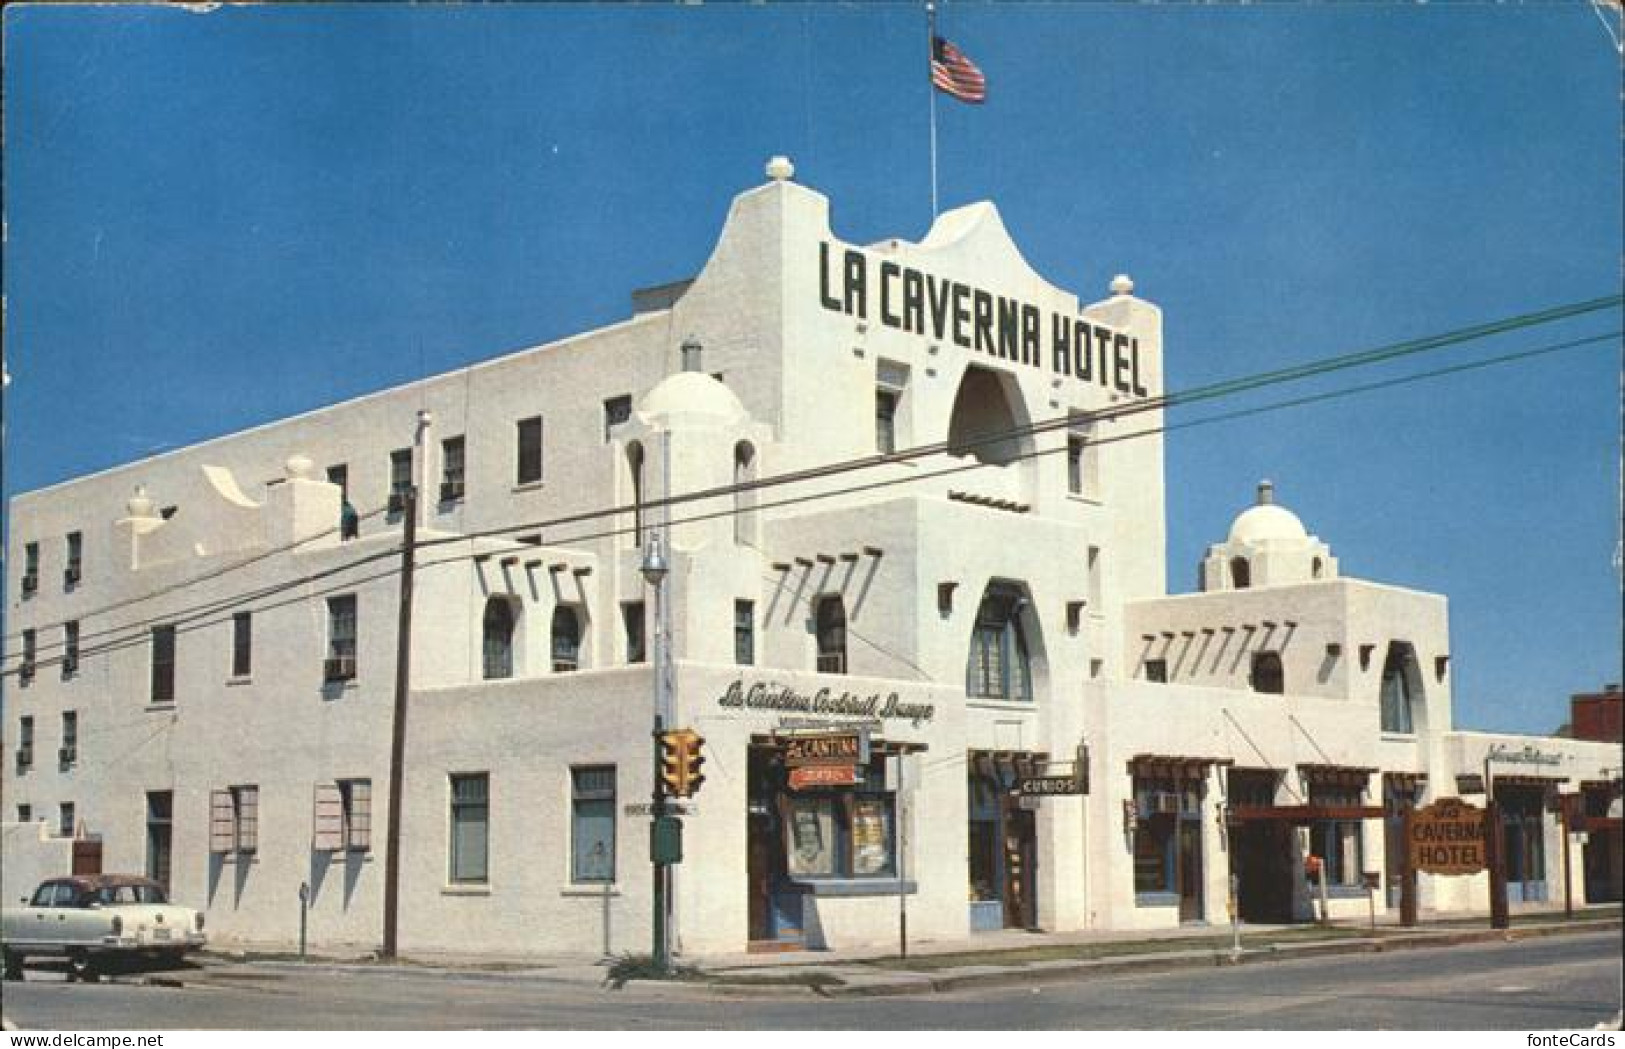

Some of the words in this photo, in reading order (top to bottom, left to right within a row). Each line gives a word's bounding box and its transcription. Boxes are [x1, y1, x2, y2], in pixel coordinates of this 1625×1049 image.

[820, 242, 866, 318] LA
[881, 261, 1040, 367] CAVERNA
[1053, 313, 1147, 397] HOTEL
[718, 680, 743, 708] La
[747, 682, 811, 712] Cantina
[813, 687, 880, 716] Cocktail
[880, 692, 935, 728] Lounge
[803, 738, 857, 757] CANTINA
[1023, 779, 1075, 793] CURIOS
[1420, 845, 1482, 865] HOTEL
